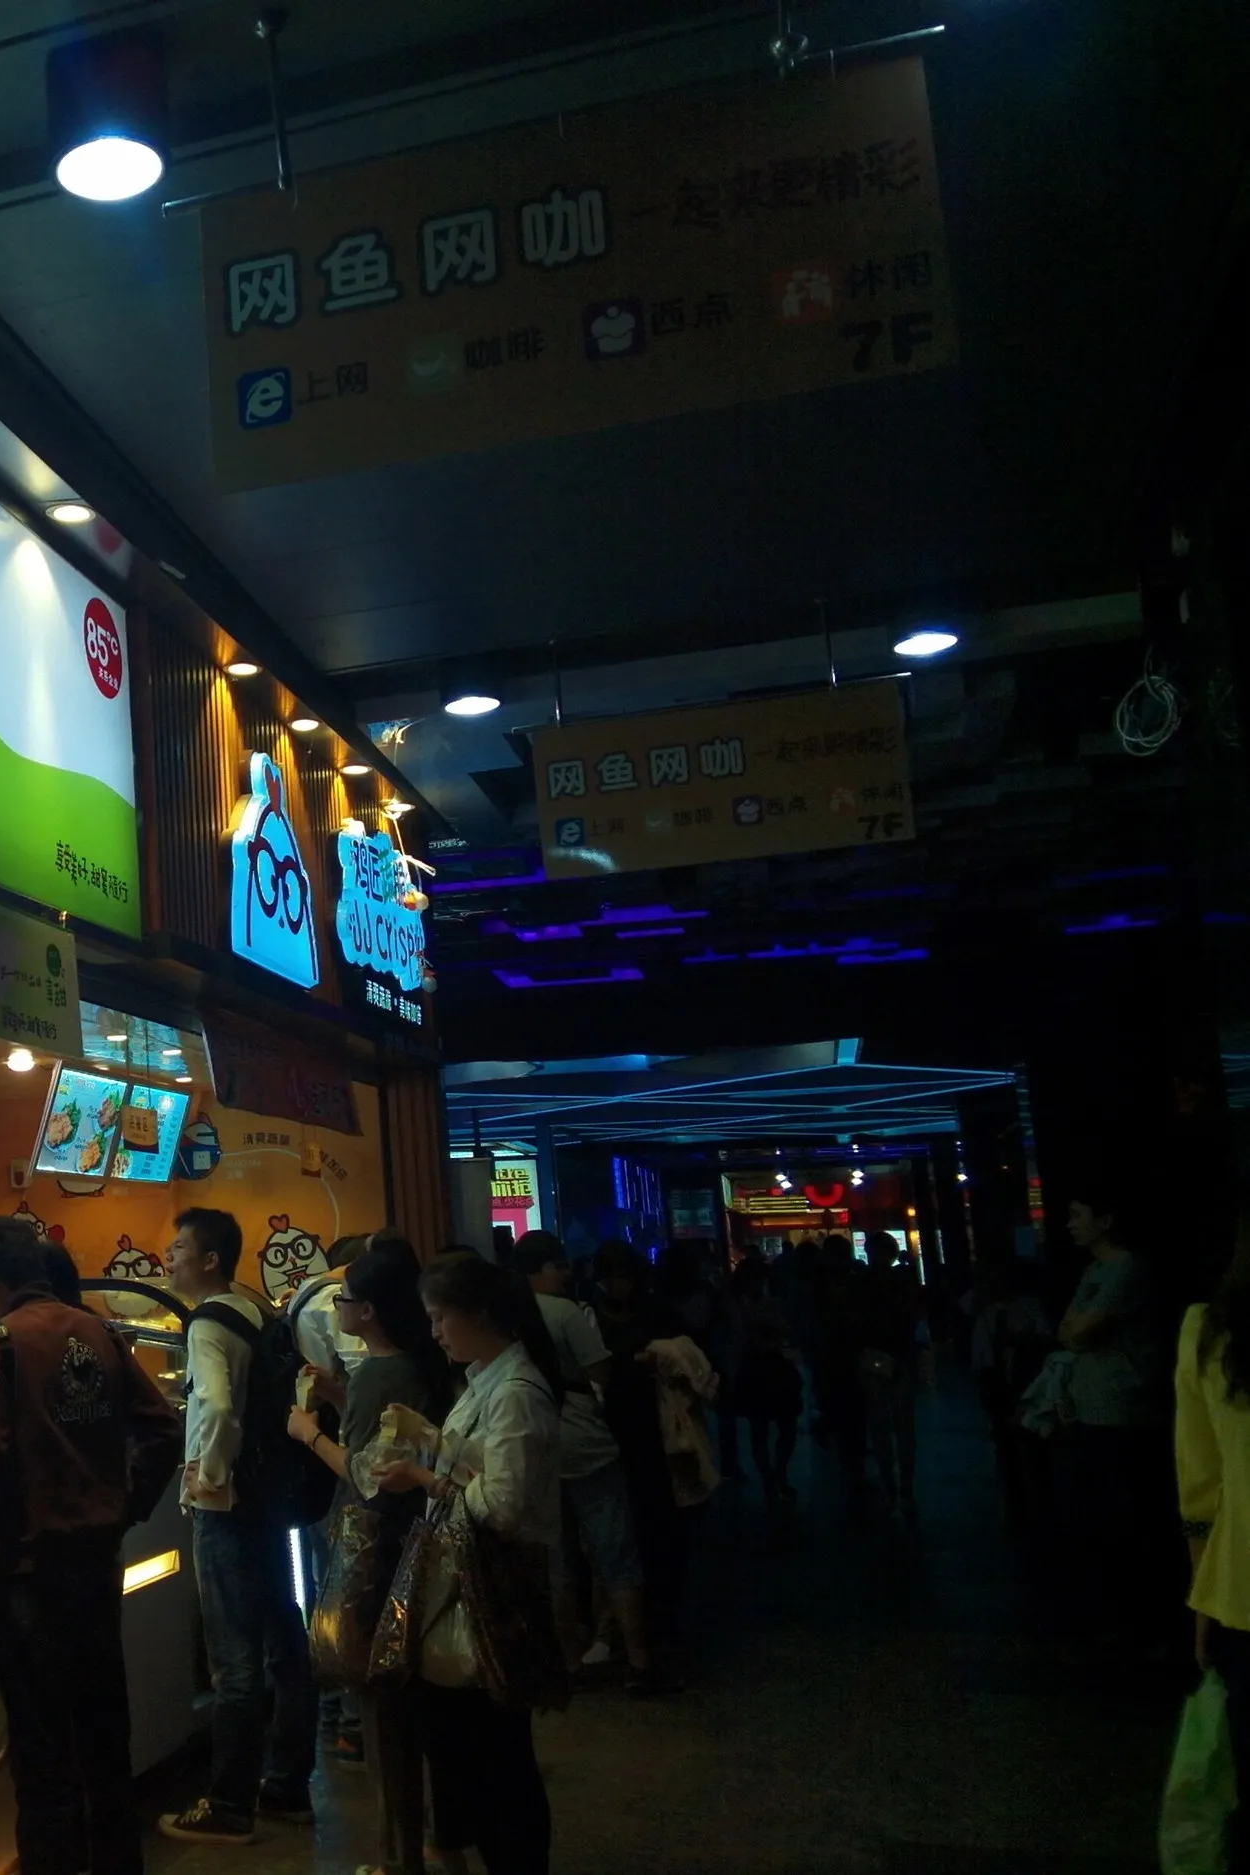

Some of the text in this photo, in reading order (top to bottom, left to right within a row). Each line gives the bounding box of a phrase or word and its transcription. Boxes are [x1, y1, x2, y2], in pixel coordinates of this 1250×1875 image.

[228, 187, 608, 333] 网鱼网咖
[299, 362, 368, 404] 上网
[649, 293, 733, 335] 西点
[842, 311, 934, 372] 7F
[548, 738, 745, 799] 网鱼网咖
[857, 812, 904, 839] 7F
